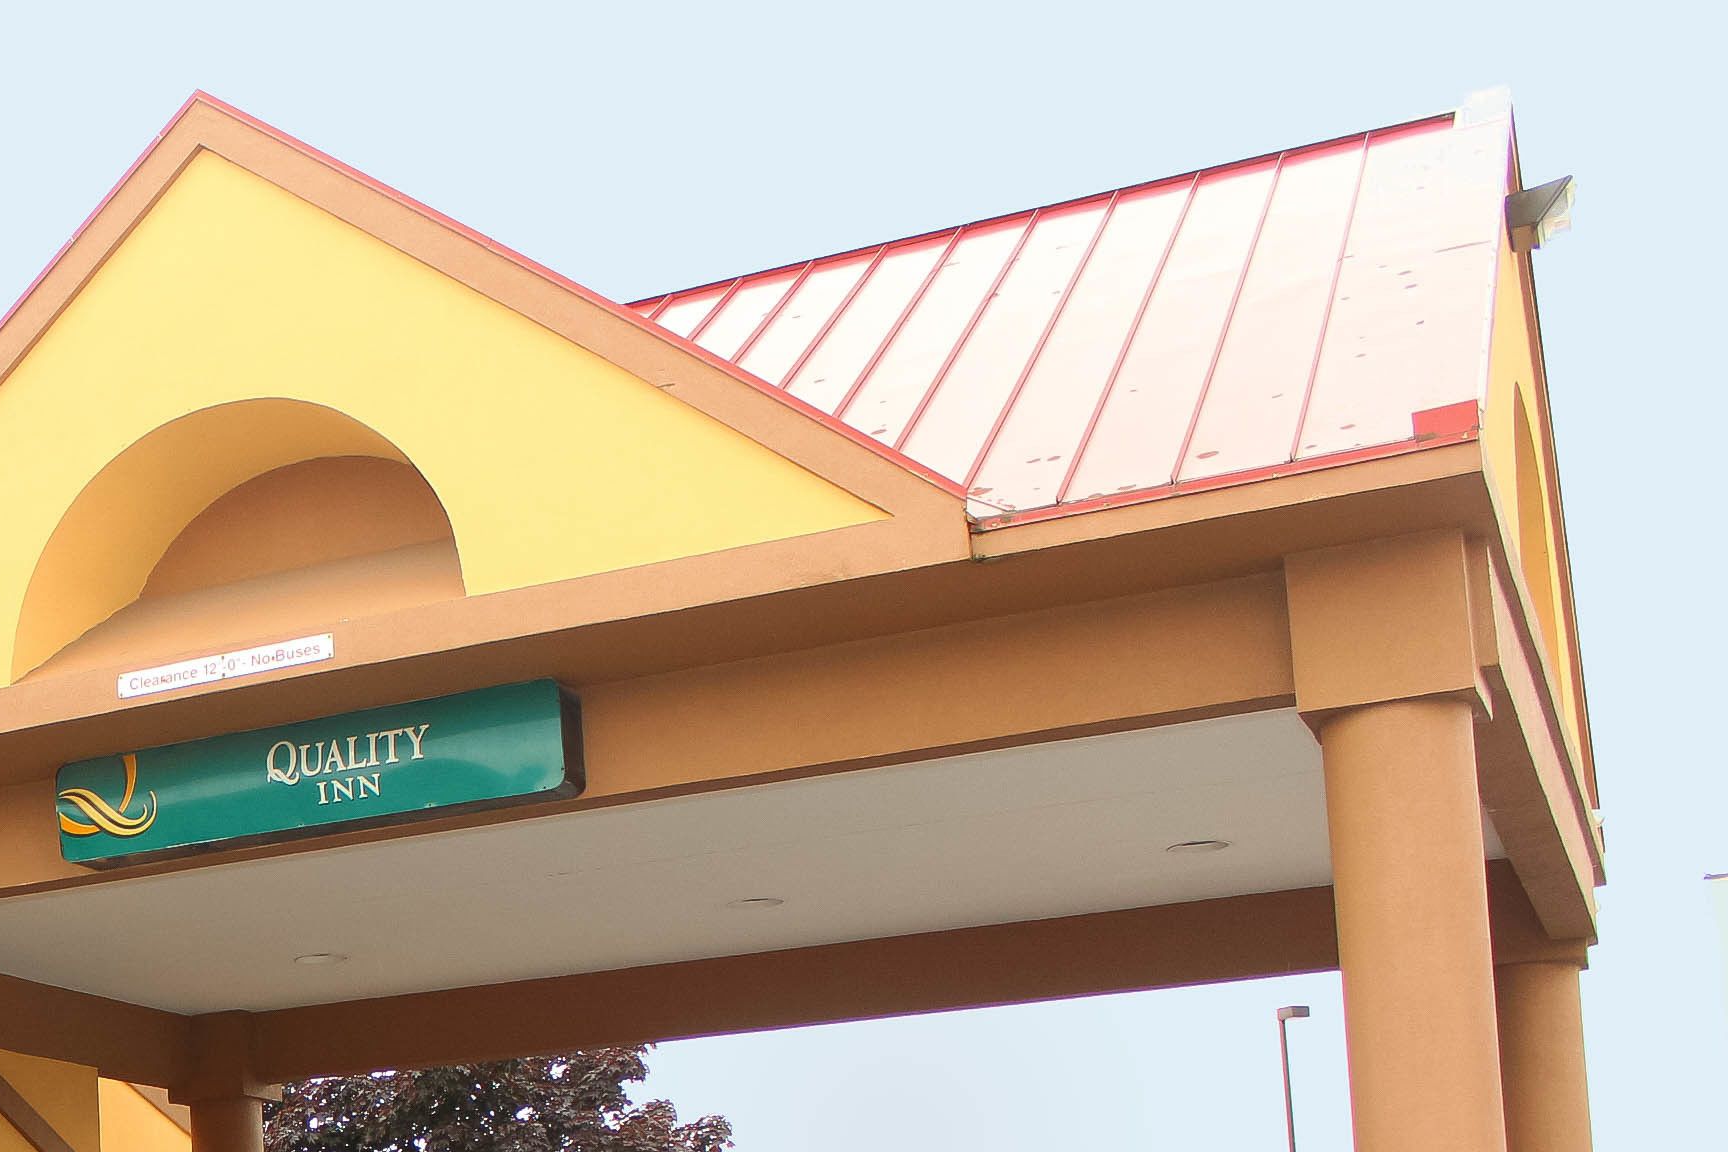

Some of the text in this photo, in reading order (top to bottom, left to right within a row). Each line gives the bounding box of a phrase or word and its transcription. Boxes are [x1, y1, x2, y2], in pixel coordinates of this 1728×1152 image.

[129, 668, 198, 690] Clearance
[251, 653, 271, 666] No
[275, 644, 321, 662] Buses
[266, 724, 430, 786] QUALITY
[316, 773, 381, 805] INN
